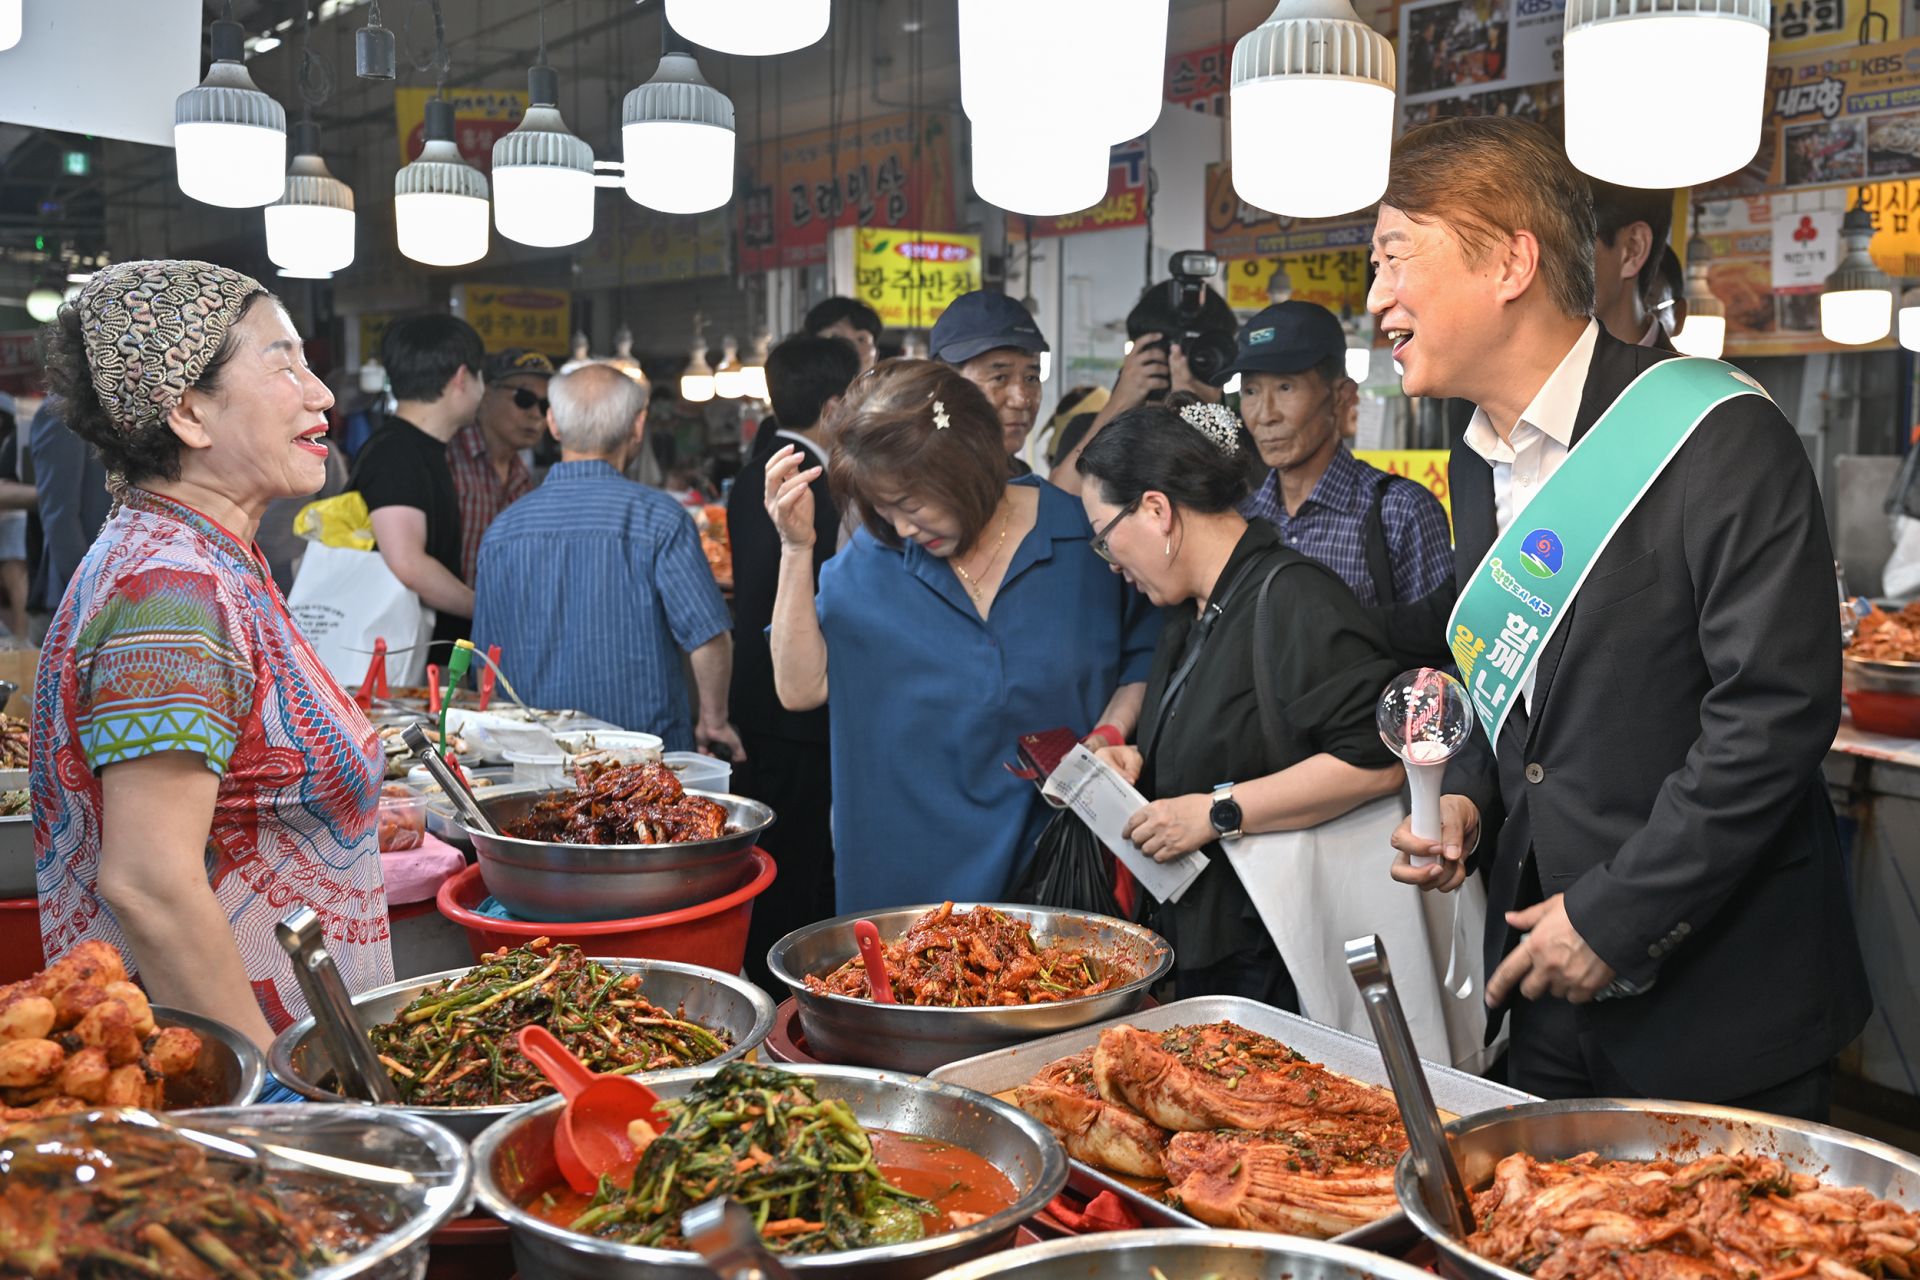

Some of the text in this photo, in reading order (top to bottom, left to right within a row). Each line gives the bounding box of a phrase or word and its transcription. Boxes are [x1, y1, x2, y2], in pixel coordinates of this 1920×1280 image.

[1769, 0, 1843, 41] 상회
[1862, 54, 1903, 76] KBS
[1775, 76, 1845, 120] 내고향
[1490, 557, 1553, 617] #착한도시 서구
[1486, 611, 1540, 681] 함께
